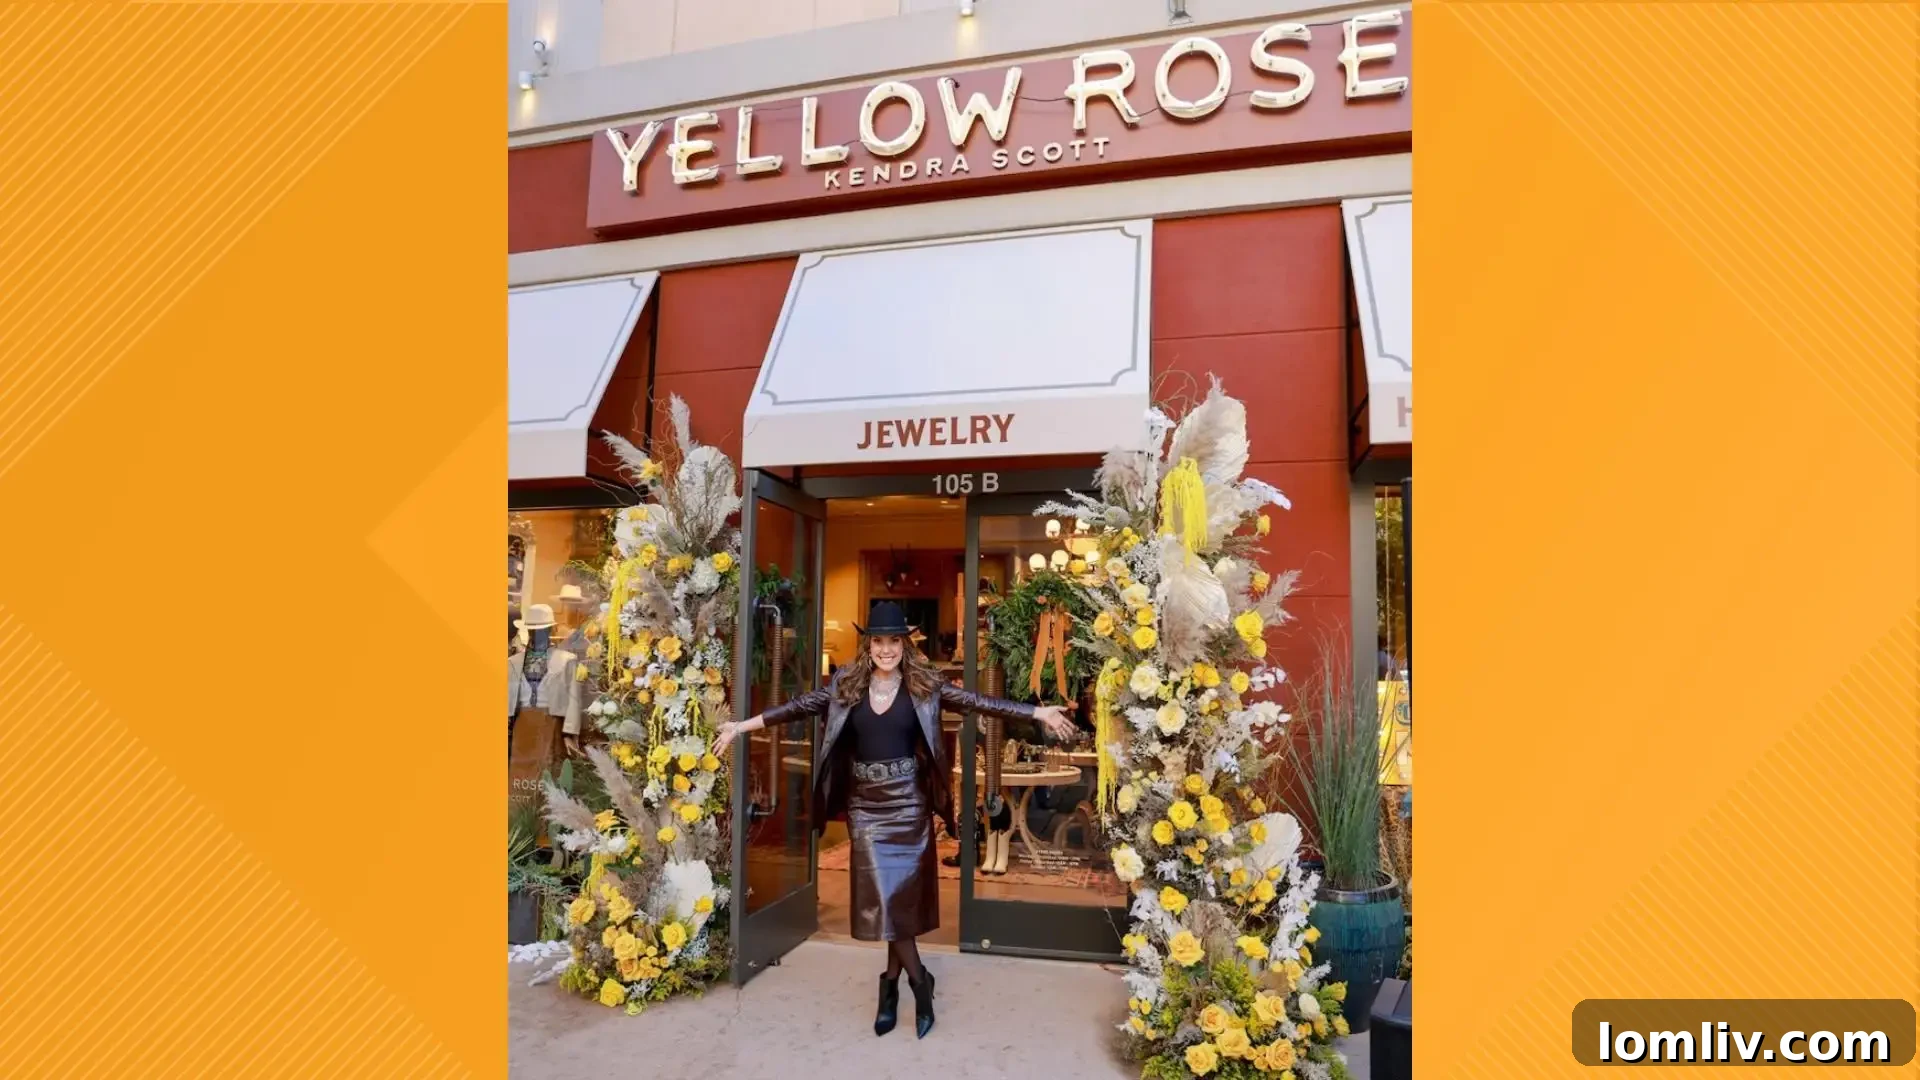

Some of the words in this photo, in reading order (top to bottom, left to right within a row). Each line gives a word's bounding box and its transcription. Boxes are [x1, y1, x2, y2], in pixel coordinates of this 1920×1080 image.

[606, 67, 1022, 192] YELLOW
[1065, 9, 1409, 132] ROSE
[824, 153, 970, 189] KENDRA
[991, 137, 1111, 169] SCOTT
[857, 413, 1015, 449] JEWELRY
[932, 473, 973, 495] 105
[982, 472, 999, 492] B
[513, 778, 545, 791] ROSE
